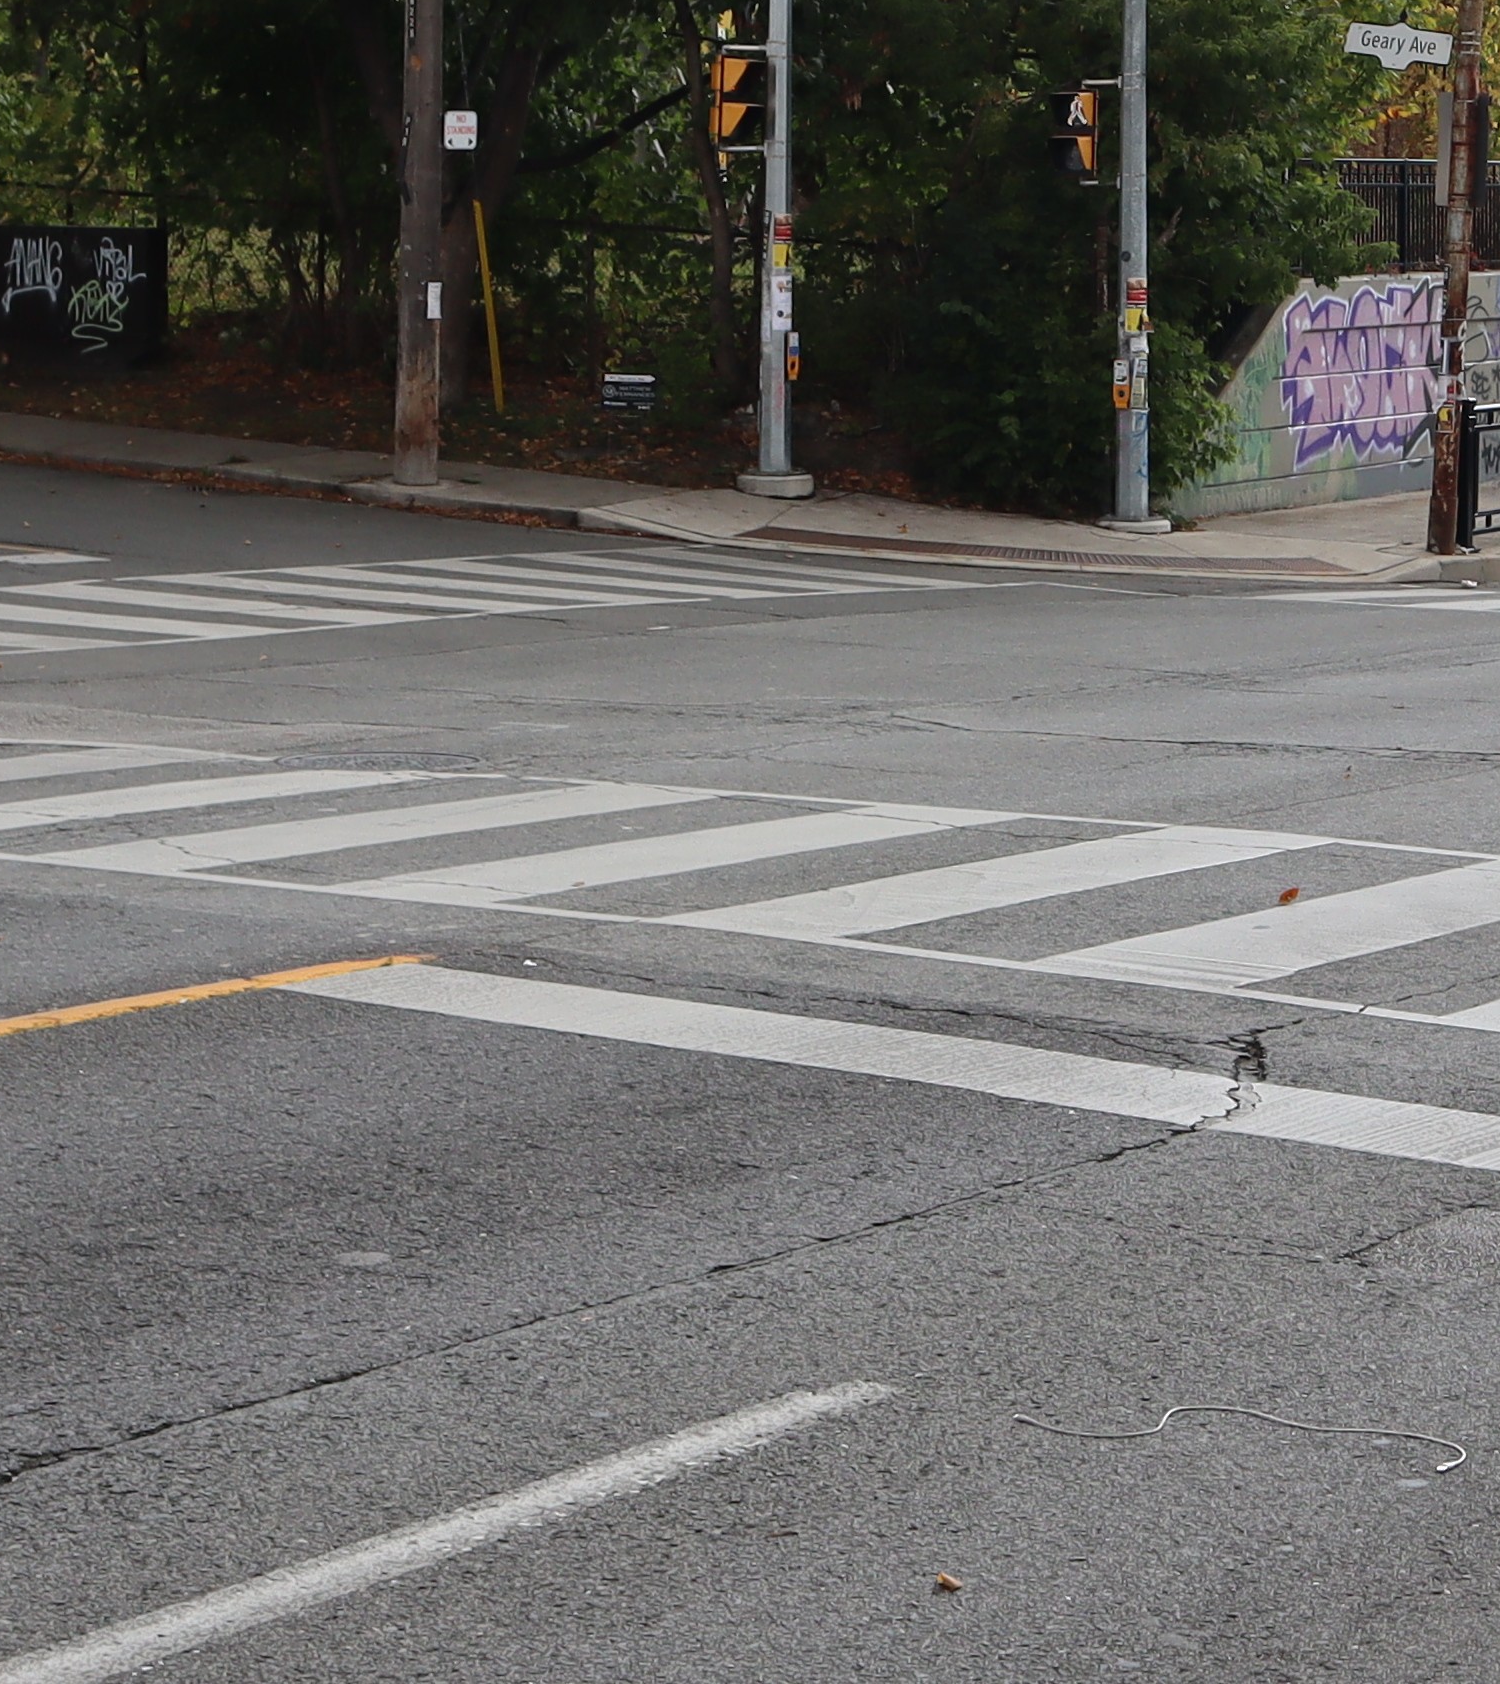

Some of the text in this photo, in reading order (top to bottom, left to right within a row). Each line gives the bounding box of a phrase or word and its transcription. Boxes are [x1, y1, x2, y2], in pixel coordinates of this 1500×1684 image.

[1361, 29, 1437, 56] Geary Ave
[456, 113, 467, 124] NO
[446, 125, 476, 136] STANDING
